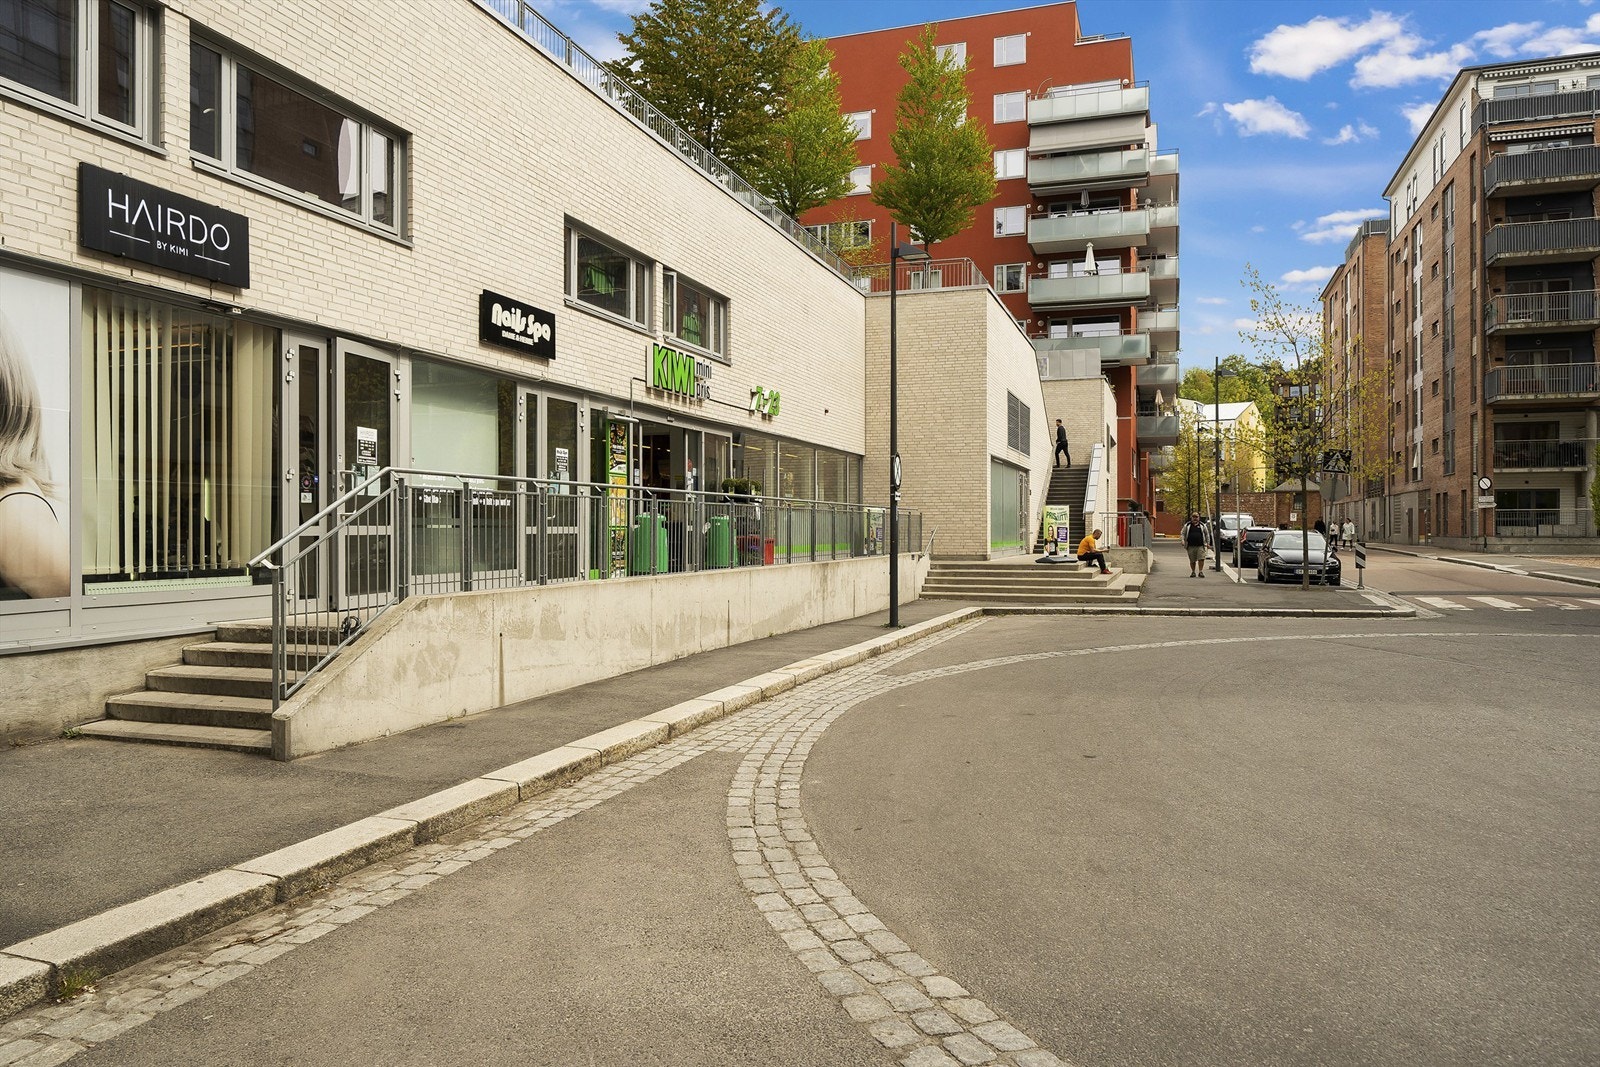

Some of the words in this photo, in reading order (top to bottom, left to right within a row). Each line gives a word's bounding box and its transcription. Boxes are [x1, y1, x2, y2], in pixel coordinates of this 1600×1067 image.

[108, 188, 230, 251] HAIRDO
[156, 240, 168, 251] BY
[169, 244, 189, 257] KIMI
[526, 314, 551, 343] Spa
[652, 342, 696, 398] KIWI
[696, 359, 712, 380] mini
[696, 380, 711, 400] pris
